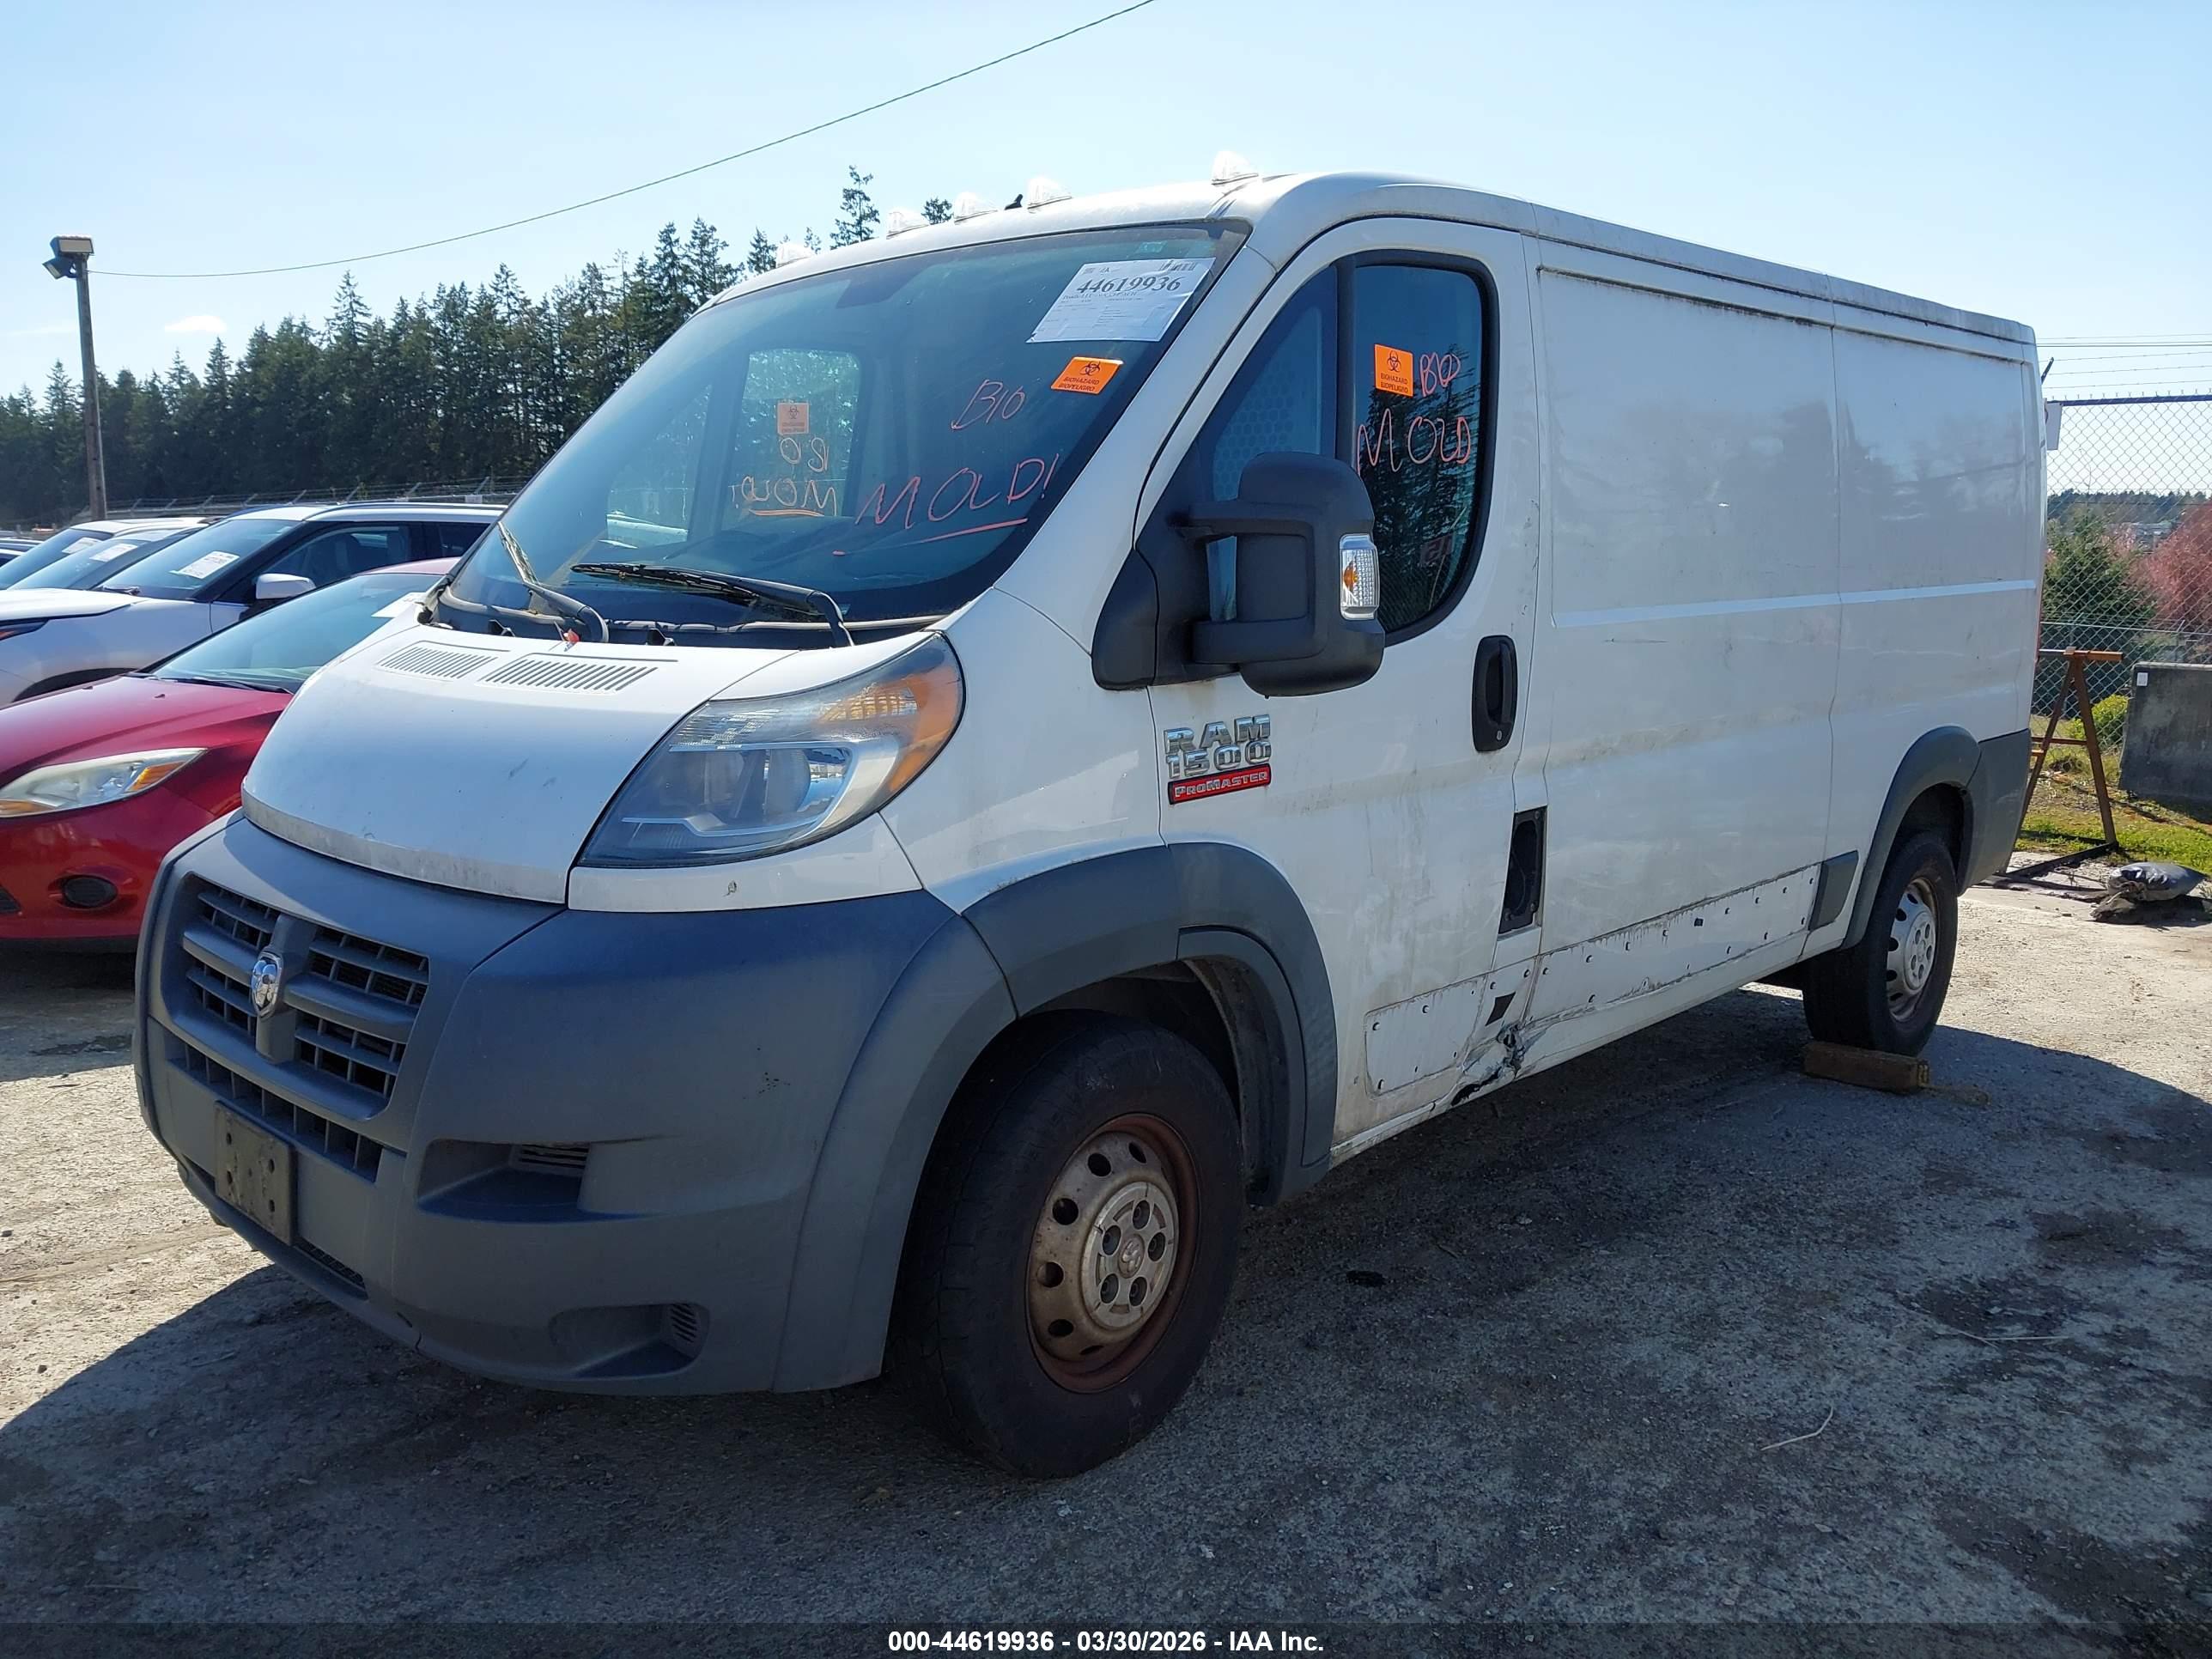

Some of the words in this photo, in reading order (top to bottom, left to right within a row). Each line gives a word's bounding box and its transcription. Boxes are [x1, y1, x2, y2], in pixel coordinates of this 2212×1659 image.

[1077, 276, 1182, 294] 44619936
[1058, 383, 1096, 392] BIOPELIGRO
[1063, 377, 1100, 386] BIOHAZARD
[1380, 373, 1408, 385] BIOHAZARD
[950, 379, 1025, 431] BIO
[1357, 408, 1471, 477] MOLD
[1164, 714, 1271, 754] RAM
[1166, 739, 1272, 779] 1500
